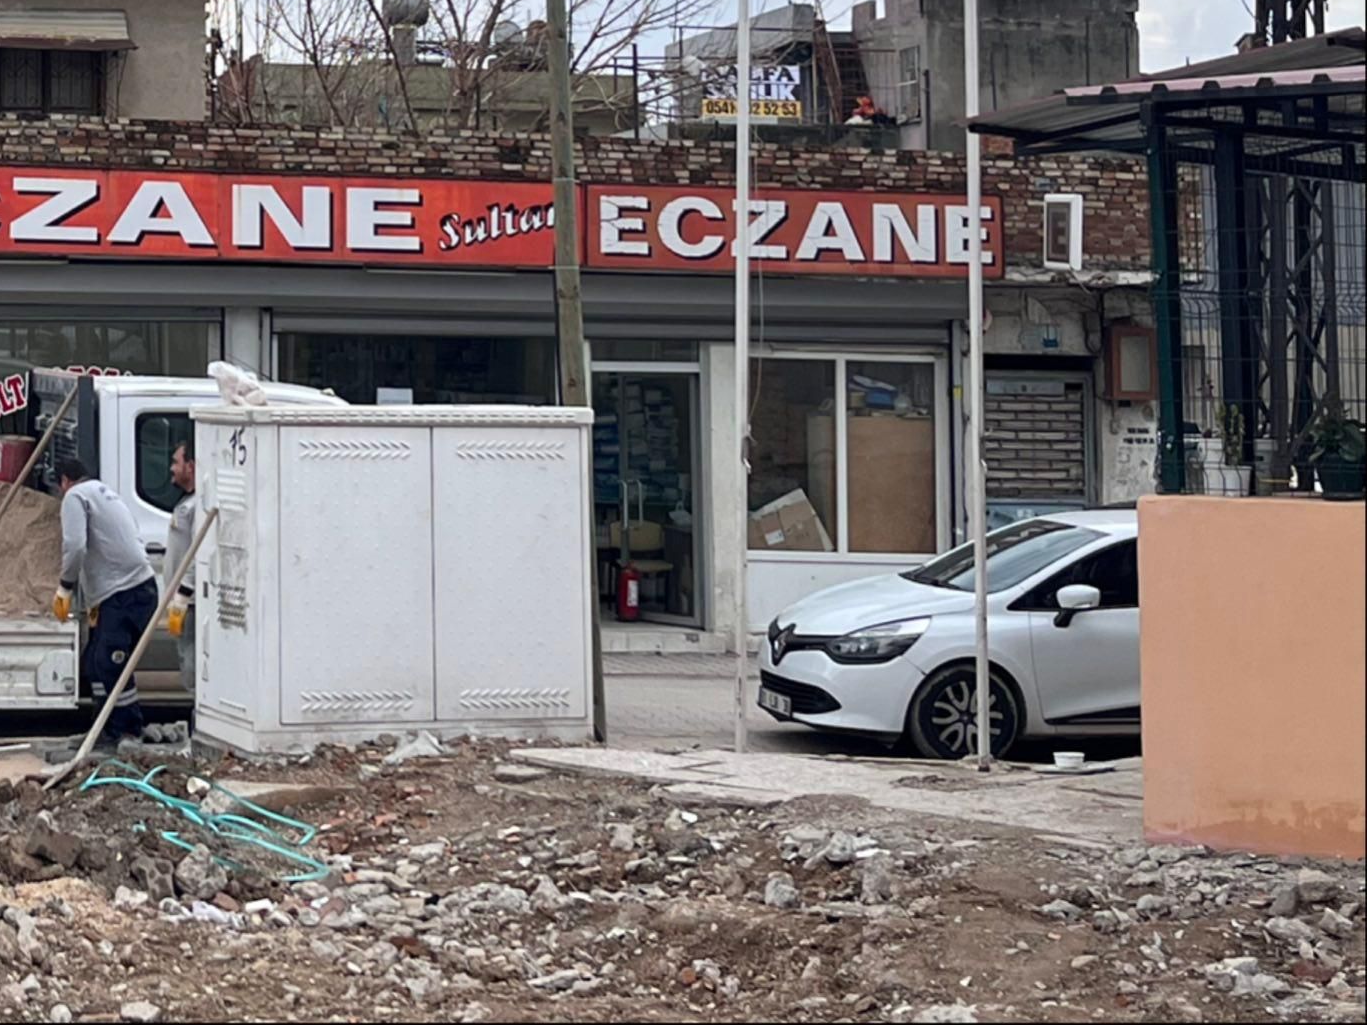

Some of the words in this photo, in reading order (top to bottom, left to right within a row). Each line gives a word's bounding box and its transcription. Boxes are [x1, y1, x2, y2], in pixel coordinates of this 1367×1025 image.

[763, 103, 778, 115] 52
[781, 103, 797, 115] 53
[600, 195, 993, 265] ECZANE
